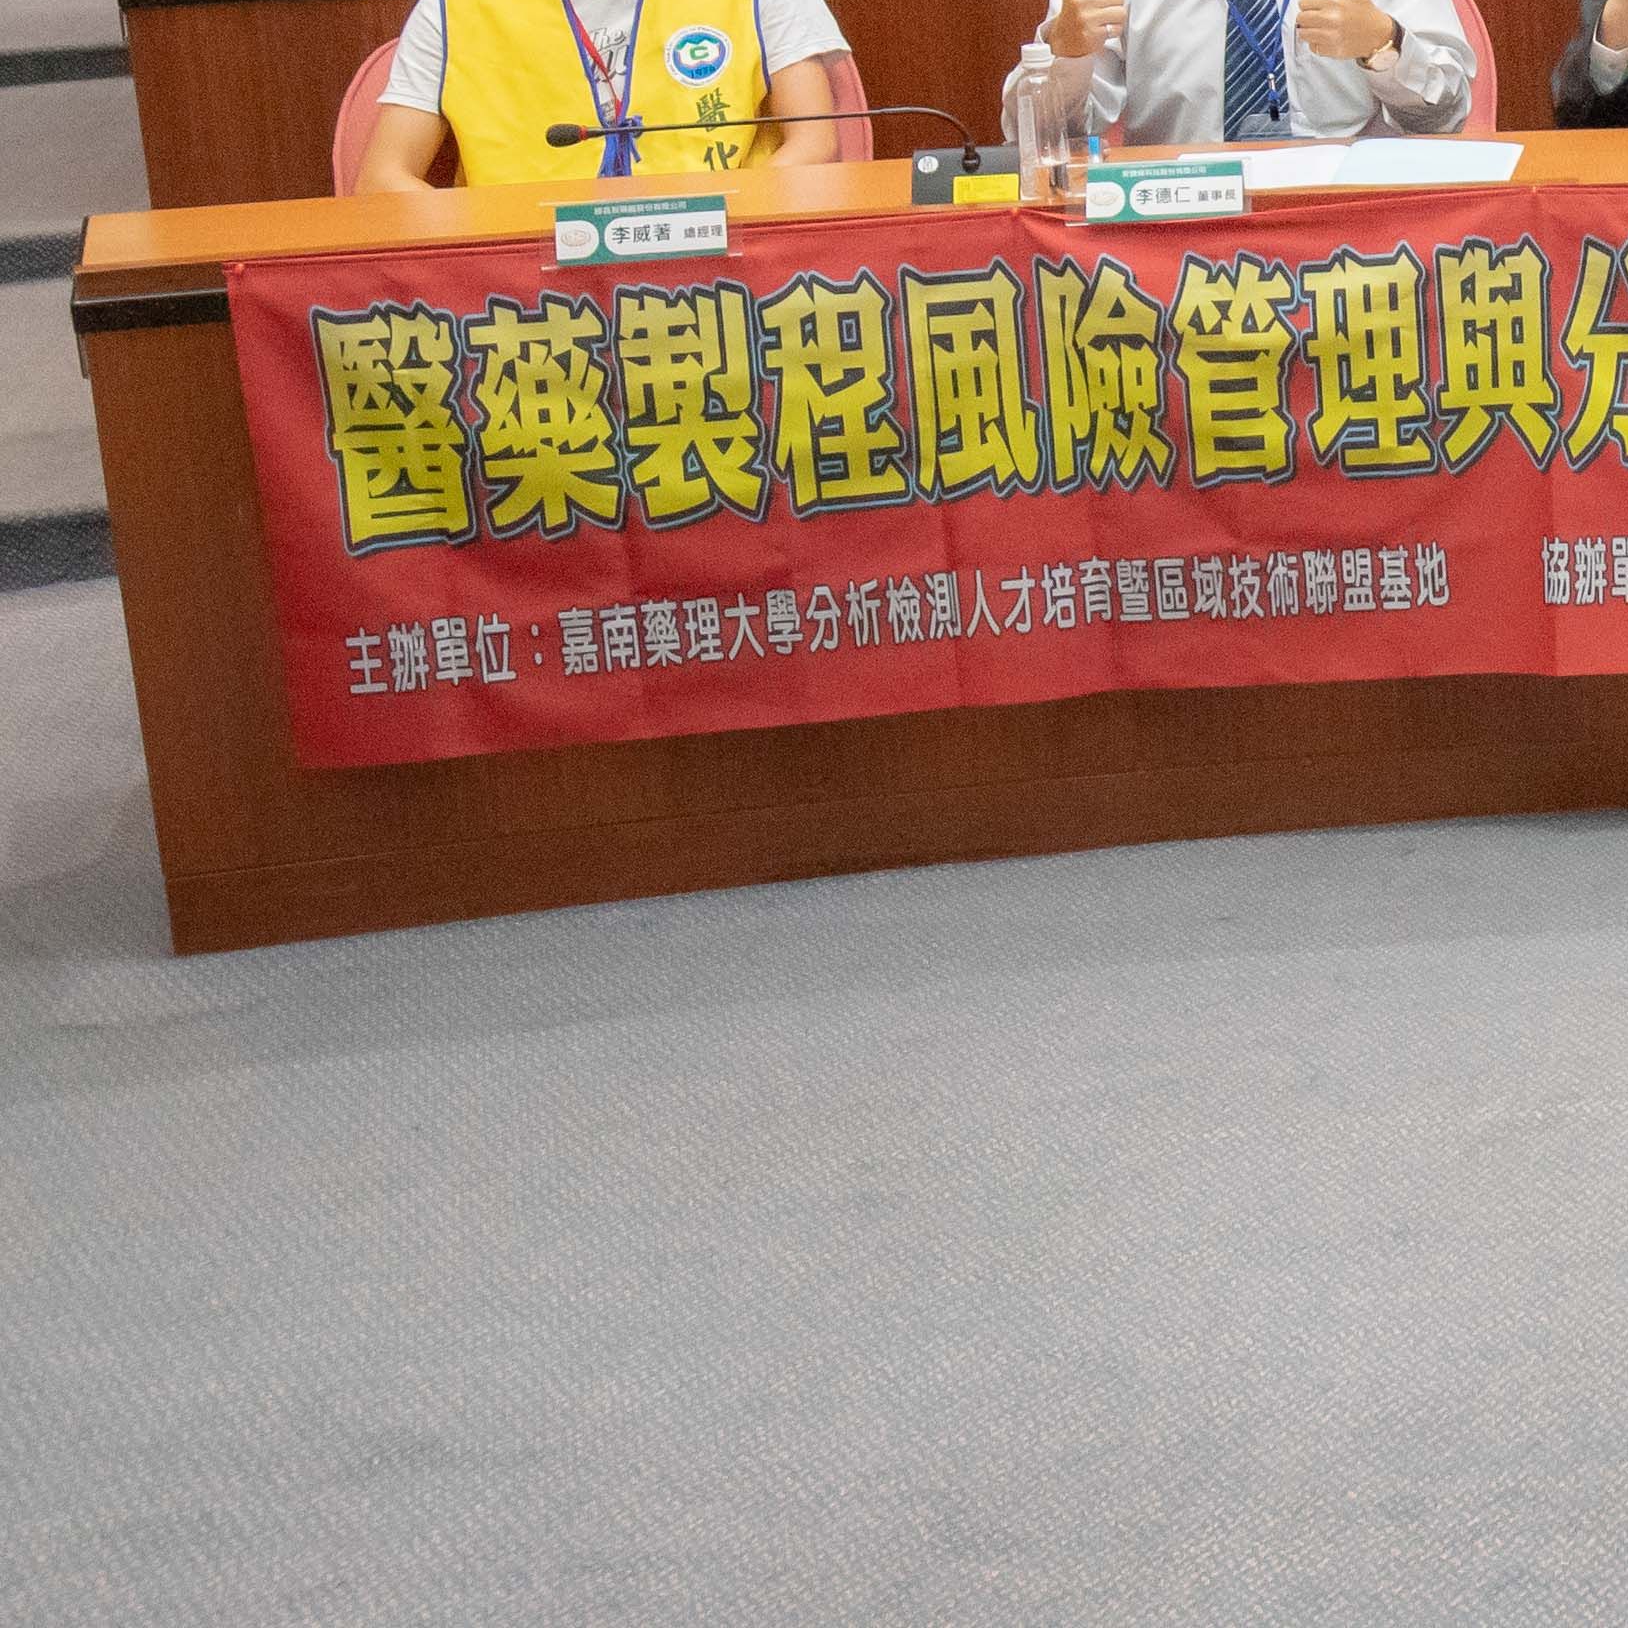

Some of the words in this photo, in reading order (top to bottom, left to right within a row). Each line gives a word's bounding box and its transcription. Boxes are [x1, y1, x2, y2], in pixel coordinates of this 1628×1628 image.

[1135, 186, 1192, 205] 李德仁
[611, 222, 671, 245] 李威著
